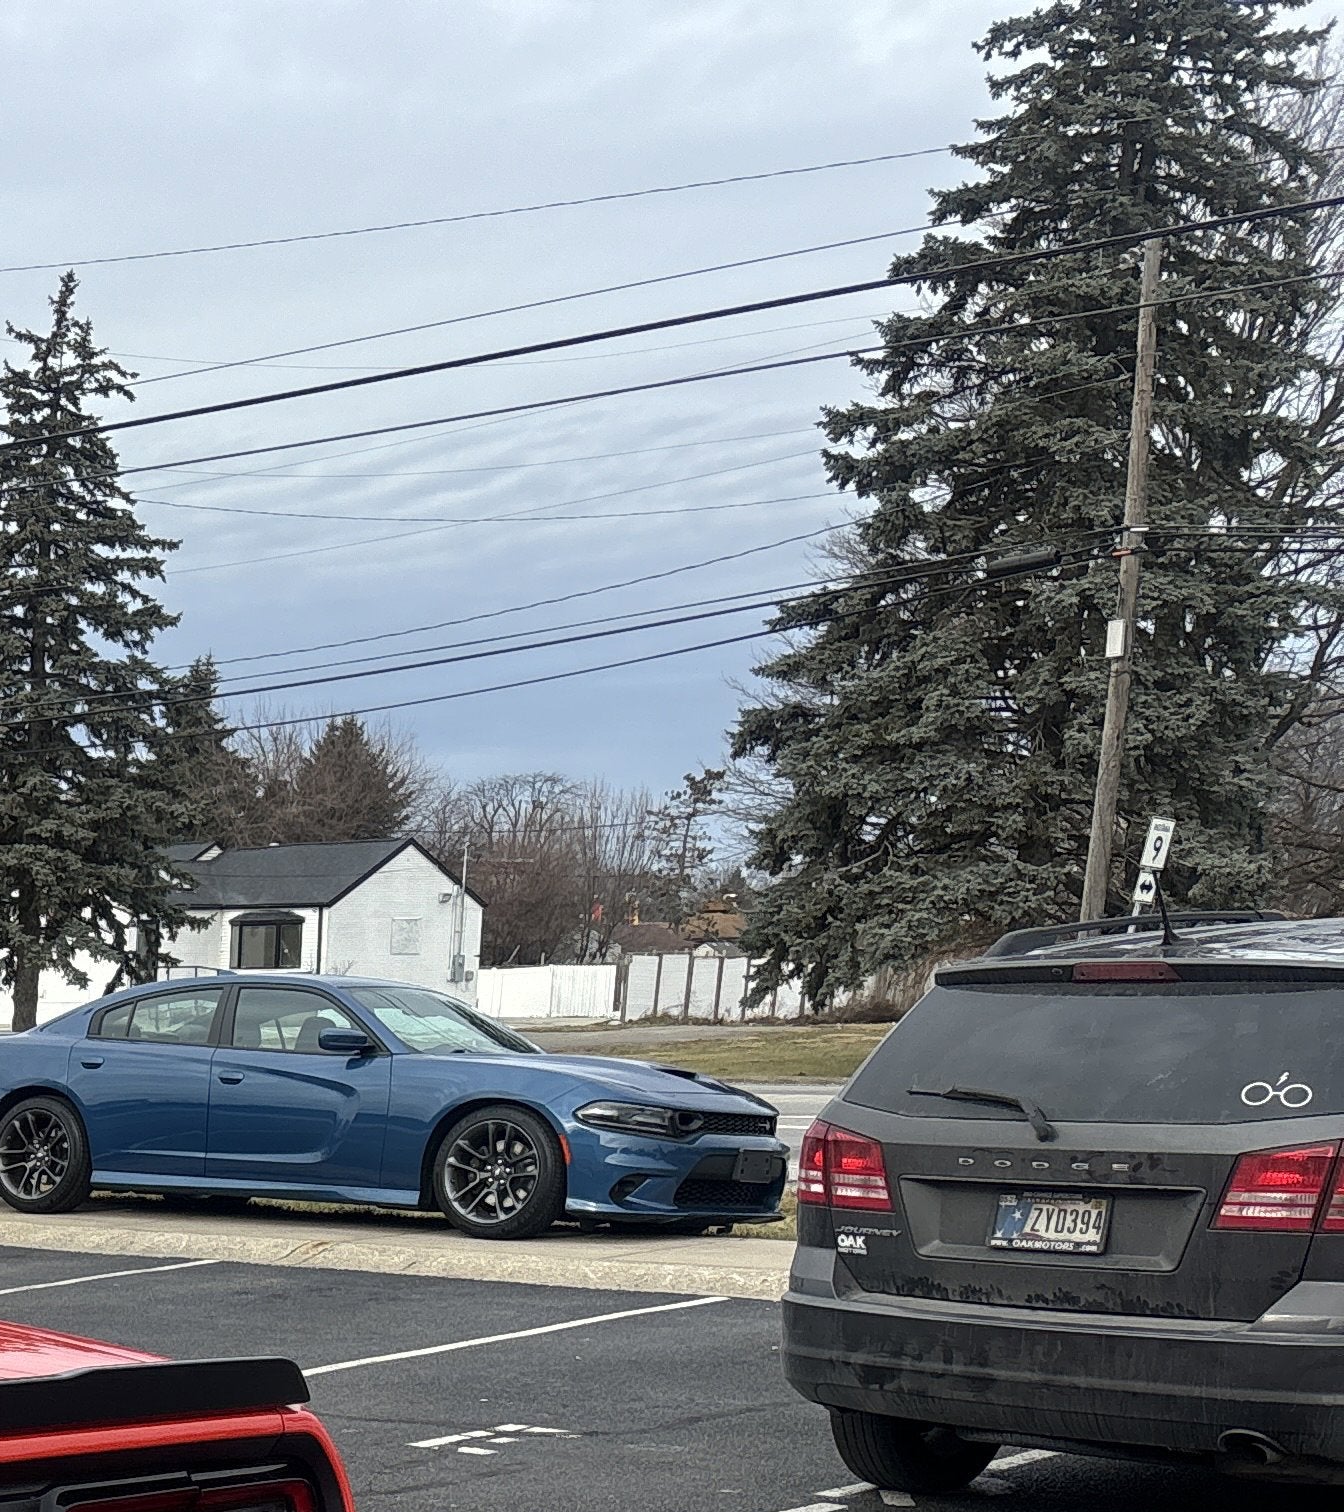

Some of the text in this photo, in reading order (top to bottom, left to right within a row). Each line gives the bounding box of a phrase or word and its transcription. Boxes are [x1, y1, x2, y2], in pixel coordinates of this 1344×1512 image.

[1152, 836, 1164, 863] 9
[958, 1157, 1129, 1171] DODGE
[834, 1225, 902, 1236] JOURNEY
[837, 1234, 867, 1249] OAK
[1012, 1239, 1075, 1251] OAKMOTORS
